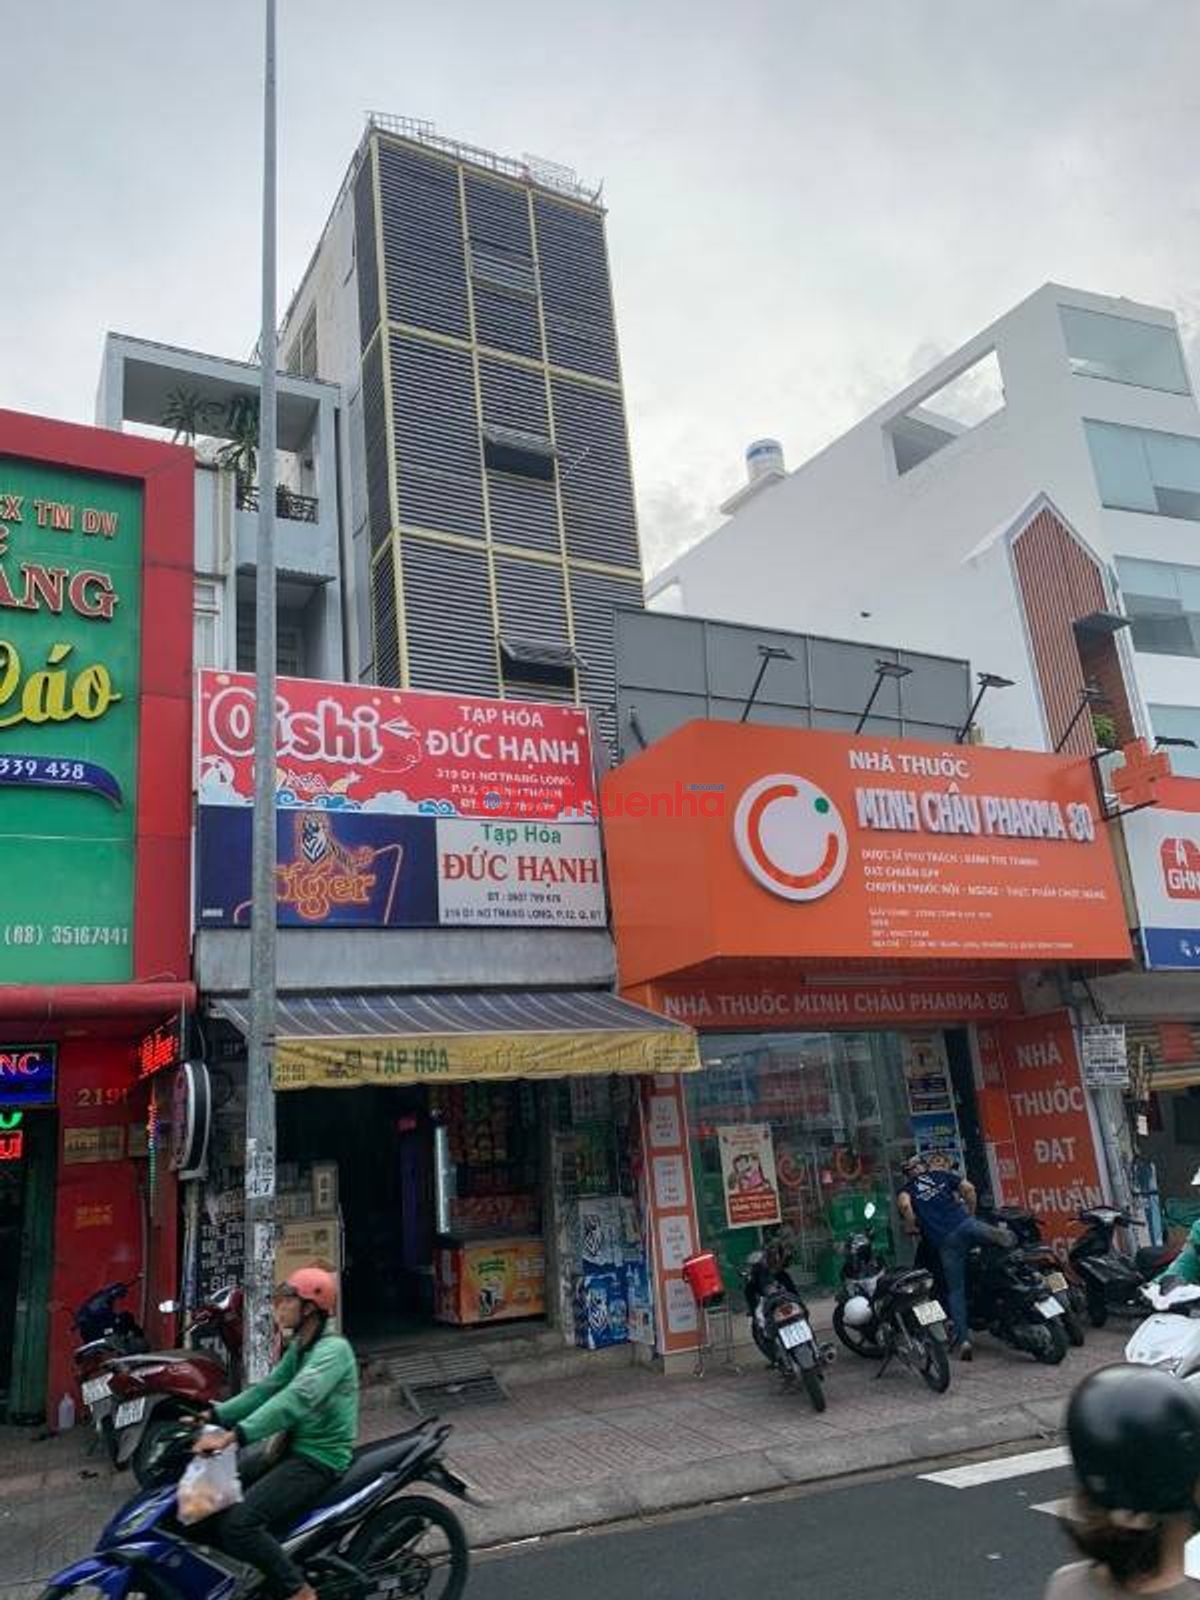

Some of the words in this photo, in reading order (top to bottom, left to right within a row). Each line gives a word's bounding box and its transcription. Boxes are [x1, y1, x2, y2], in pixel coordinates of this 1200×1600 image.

[0, 494, 23, 522] X
[82, 507, 118, 537] DV
[458, 706, 497, 727] TẠP
[501, 707, 544, 728] HÓA
[426, 727, 493, 760] ĐỨC
[498, 735, 580, 770] HẠNH
[849, 749, 896, 773] NHÀ
[898, 752, 970, 779] THUỐC
[45, 761, 85, 780] 458
[857, 787, 920, 832] MINH
[920, 781, 982, 836] CHÂU
[982, 795, 1067, 840] PHARMA
[481, 823, 518, 846] Tạp
[524, 824, 562, 845] Hóa
[443, 845, 508, 881] ĐỨC
[517, 856, 600, 889] HẠNH
[663, 990, 713, 1017] NHÀ
[717, 988, 791, 1015] THUỐC
[793, 992, 849, 1014] MINH
[853, 987, 905, 1013] CHÂU
[909, 992, 984, 1012] PHARMA
[374, 1050, 409, 1079] TẠP
[414, 1041, 449, 1073] HÓA
[1016, 1034, 1063, 1069] NHÀ
[1010, 1079, 1085, 1117] THUỐC
[1033, 1135, 1077, 1170] ĐẠT
